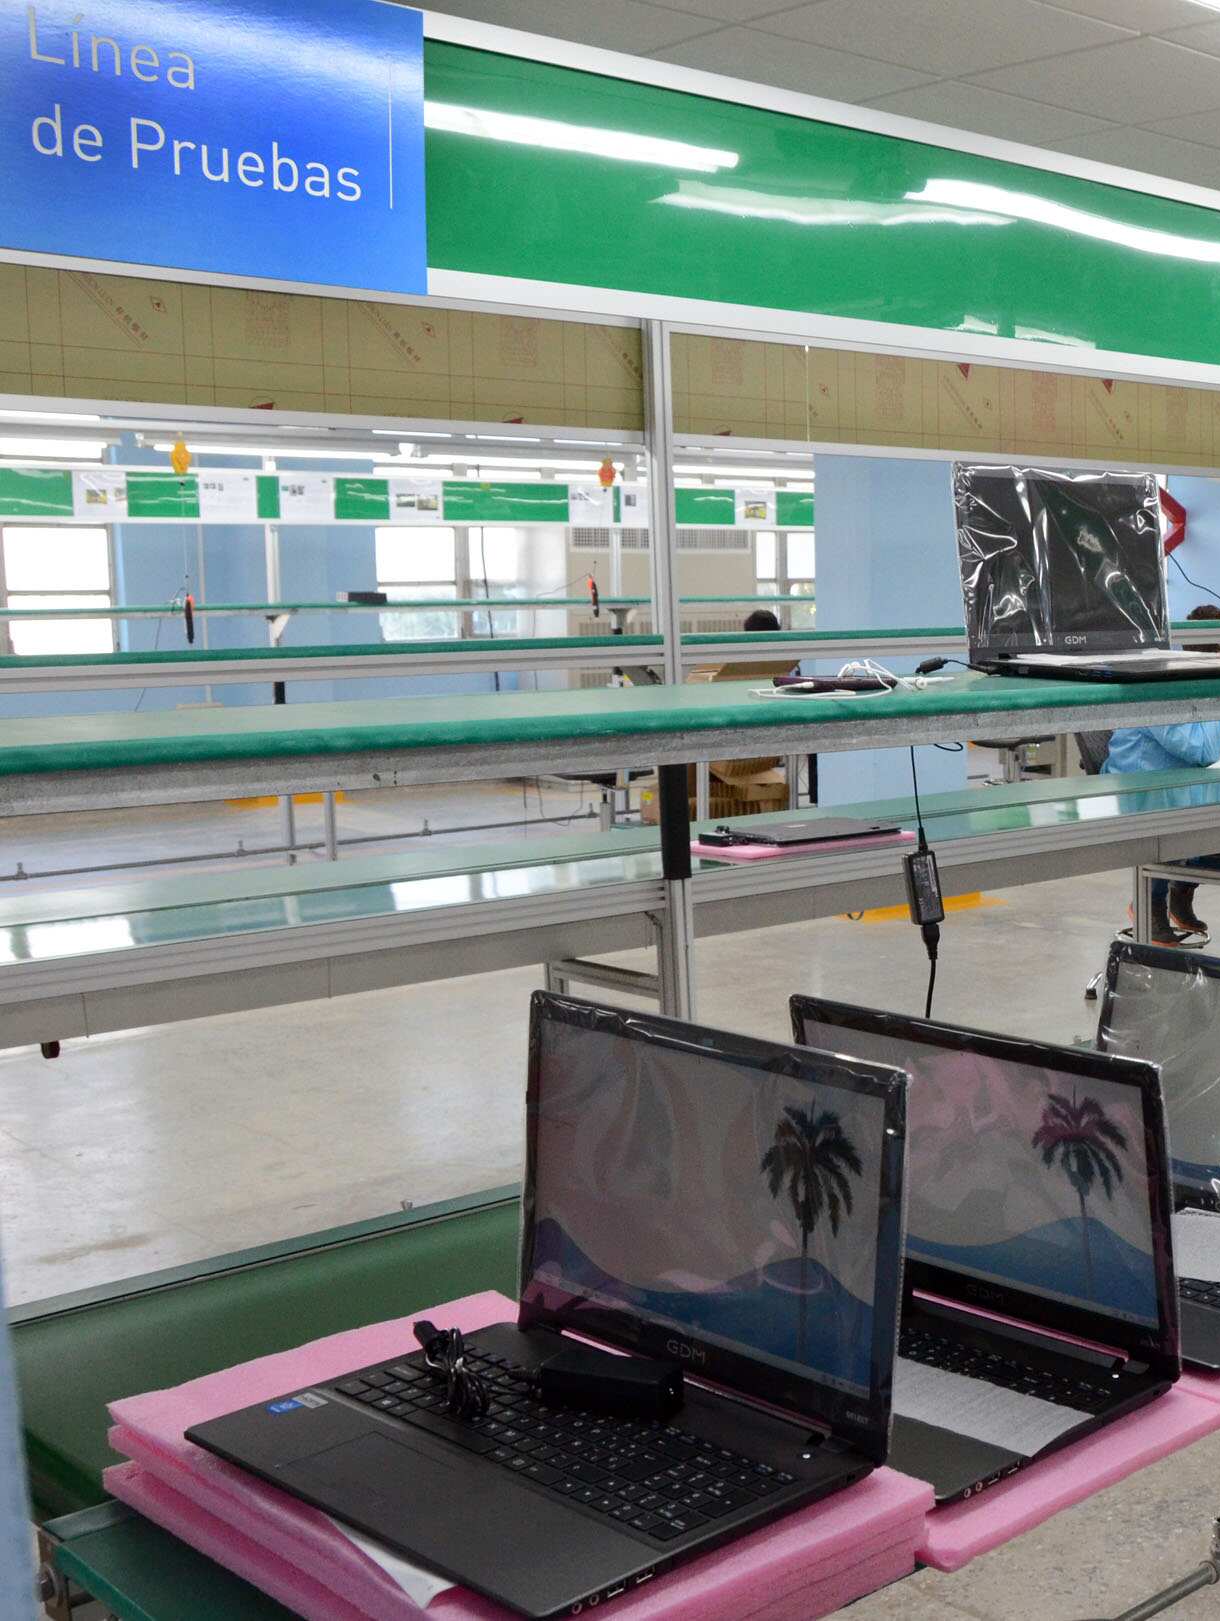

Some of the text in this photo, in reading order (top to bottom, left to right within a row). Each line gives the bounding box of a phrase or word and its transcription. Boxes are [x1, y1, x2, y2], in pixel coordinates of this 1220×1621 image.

[27, 3, 195, 90] Línea
[31, 103, 362, 202] de Pruebas
[1064, 635, 1087, 645] GDM
[666, 1339, 706, 1363] GDM
